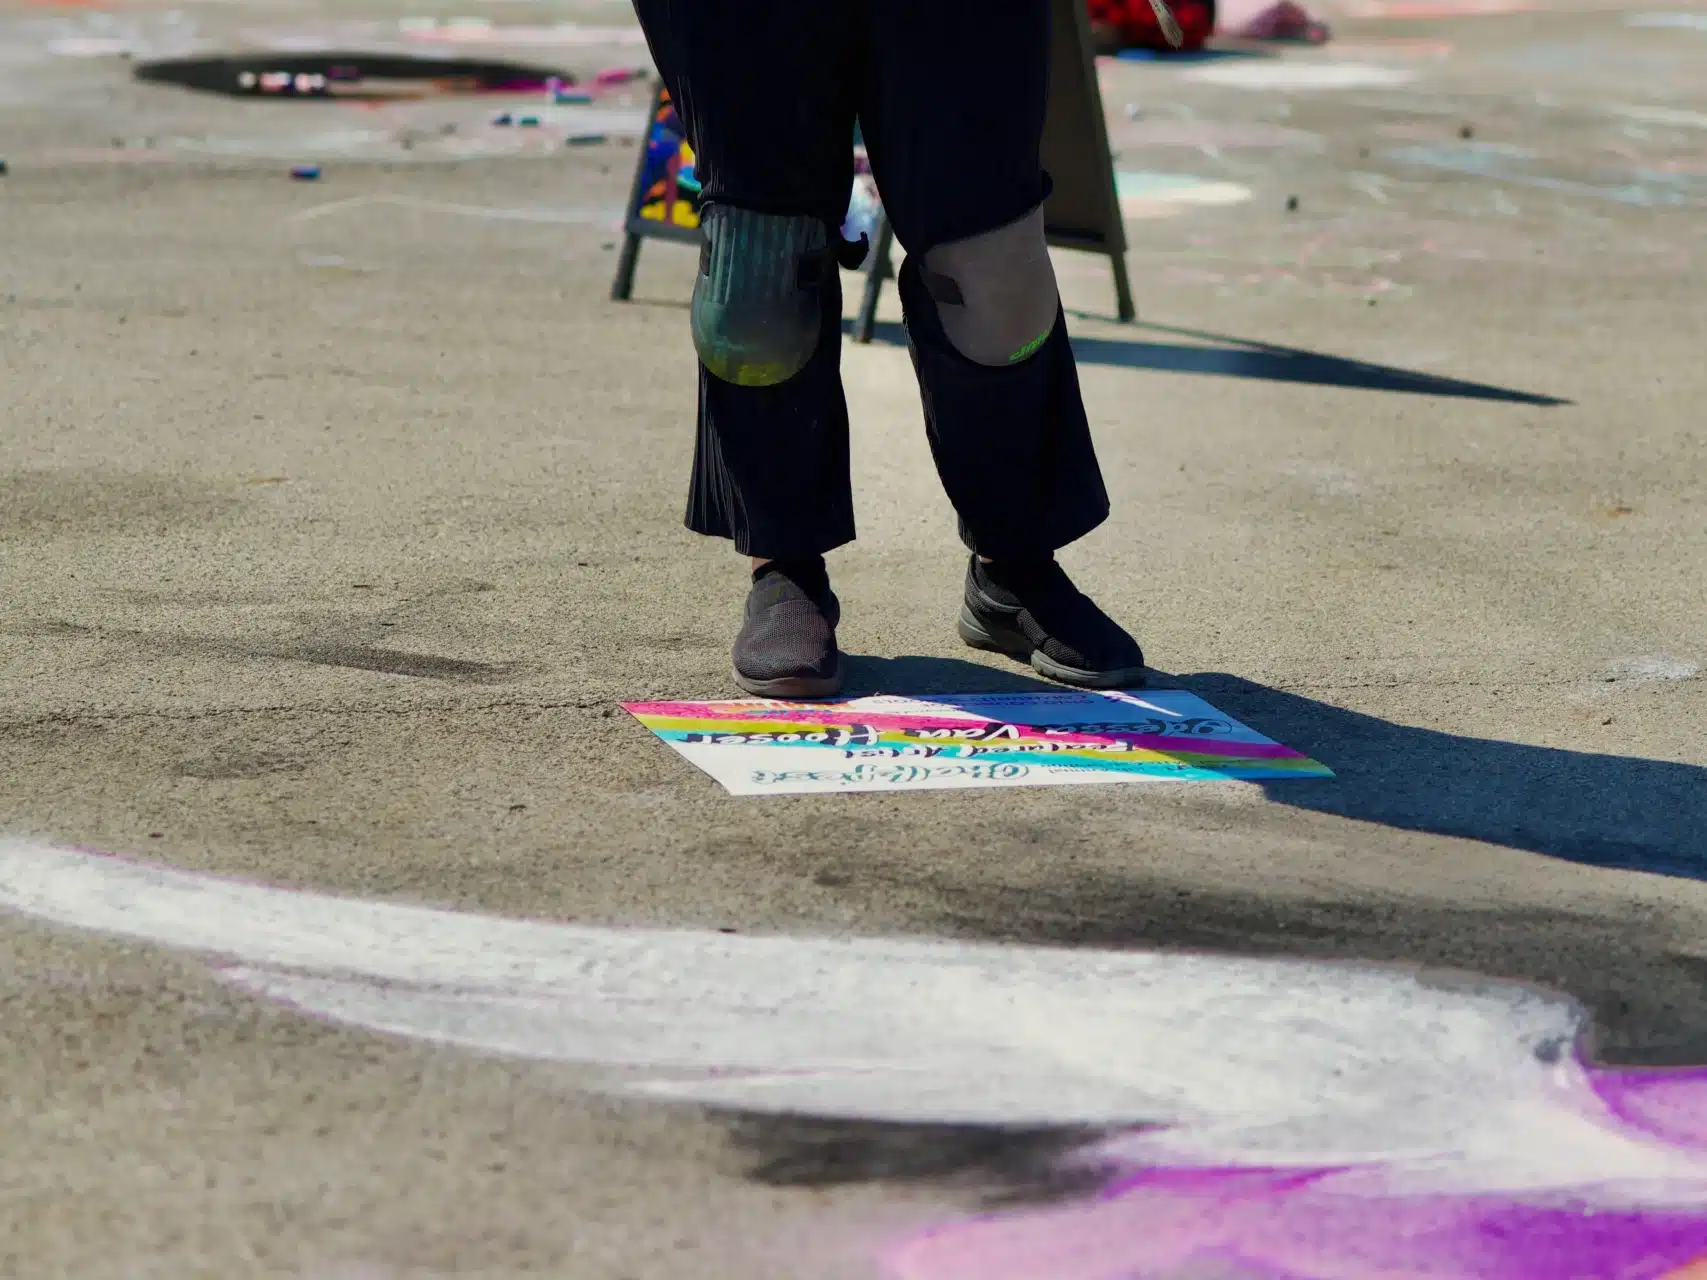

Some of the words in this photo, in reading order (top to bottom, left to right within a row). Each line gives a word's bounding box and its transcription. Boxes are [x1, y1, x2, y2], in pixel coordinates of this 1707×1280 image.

[687, 723, 886, 746] Hooser
[908, 722, 1021, 740] Van
[845, 744, 944, 759] Artist
[956, 740, 1136, 759] Featured
